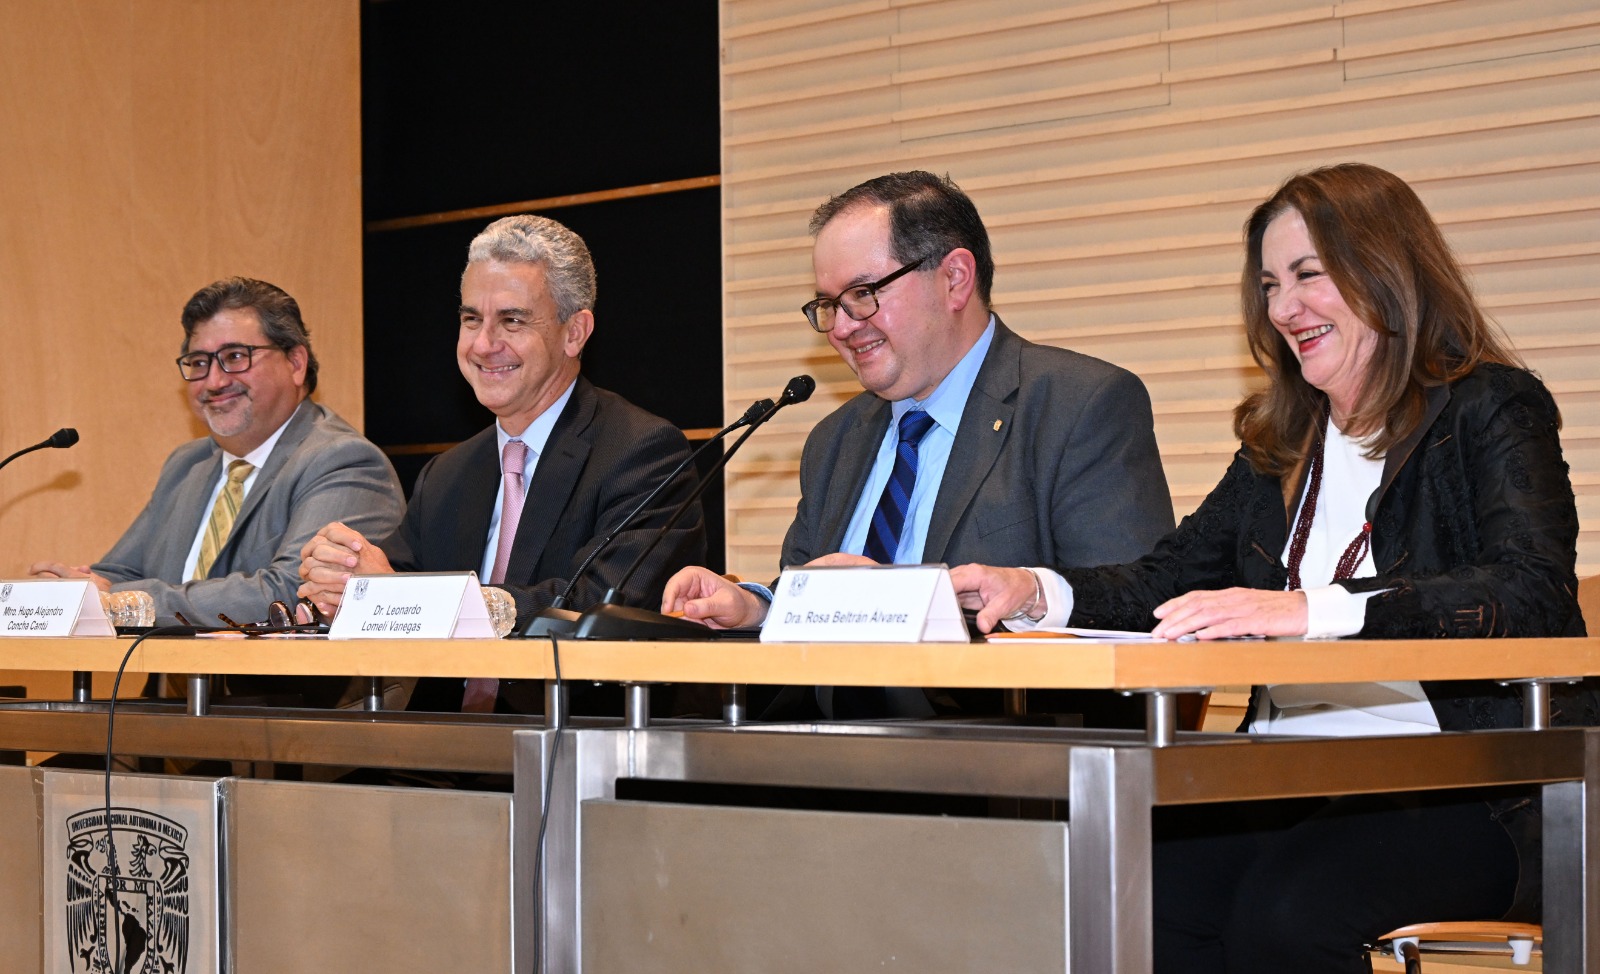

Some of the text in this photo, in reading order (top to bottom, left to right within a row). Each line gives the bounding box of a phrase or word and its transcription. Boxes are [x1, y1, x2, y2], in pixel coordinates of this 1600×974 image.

[3, 605, 64, 618] Mtro. Hugo Alejandro
[373, 604, 422, 615] Dr. Leonardo
[784, 608, 909, 624] Dra. Rosa Beltrán Álvarez
[7, 620, 48, 630] Concha Cantú
[361, 620, 421, 634] Lomelí Vanegas
[71, 815, 103, 833] UNIVERSIDAD
[104, 814, 128, 826] NCIONAL
[129, 815, 157, 830] AUTONOMA
[163, 824, 183, 843] MEXICO
[134, 880, 147, 893] MI
